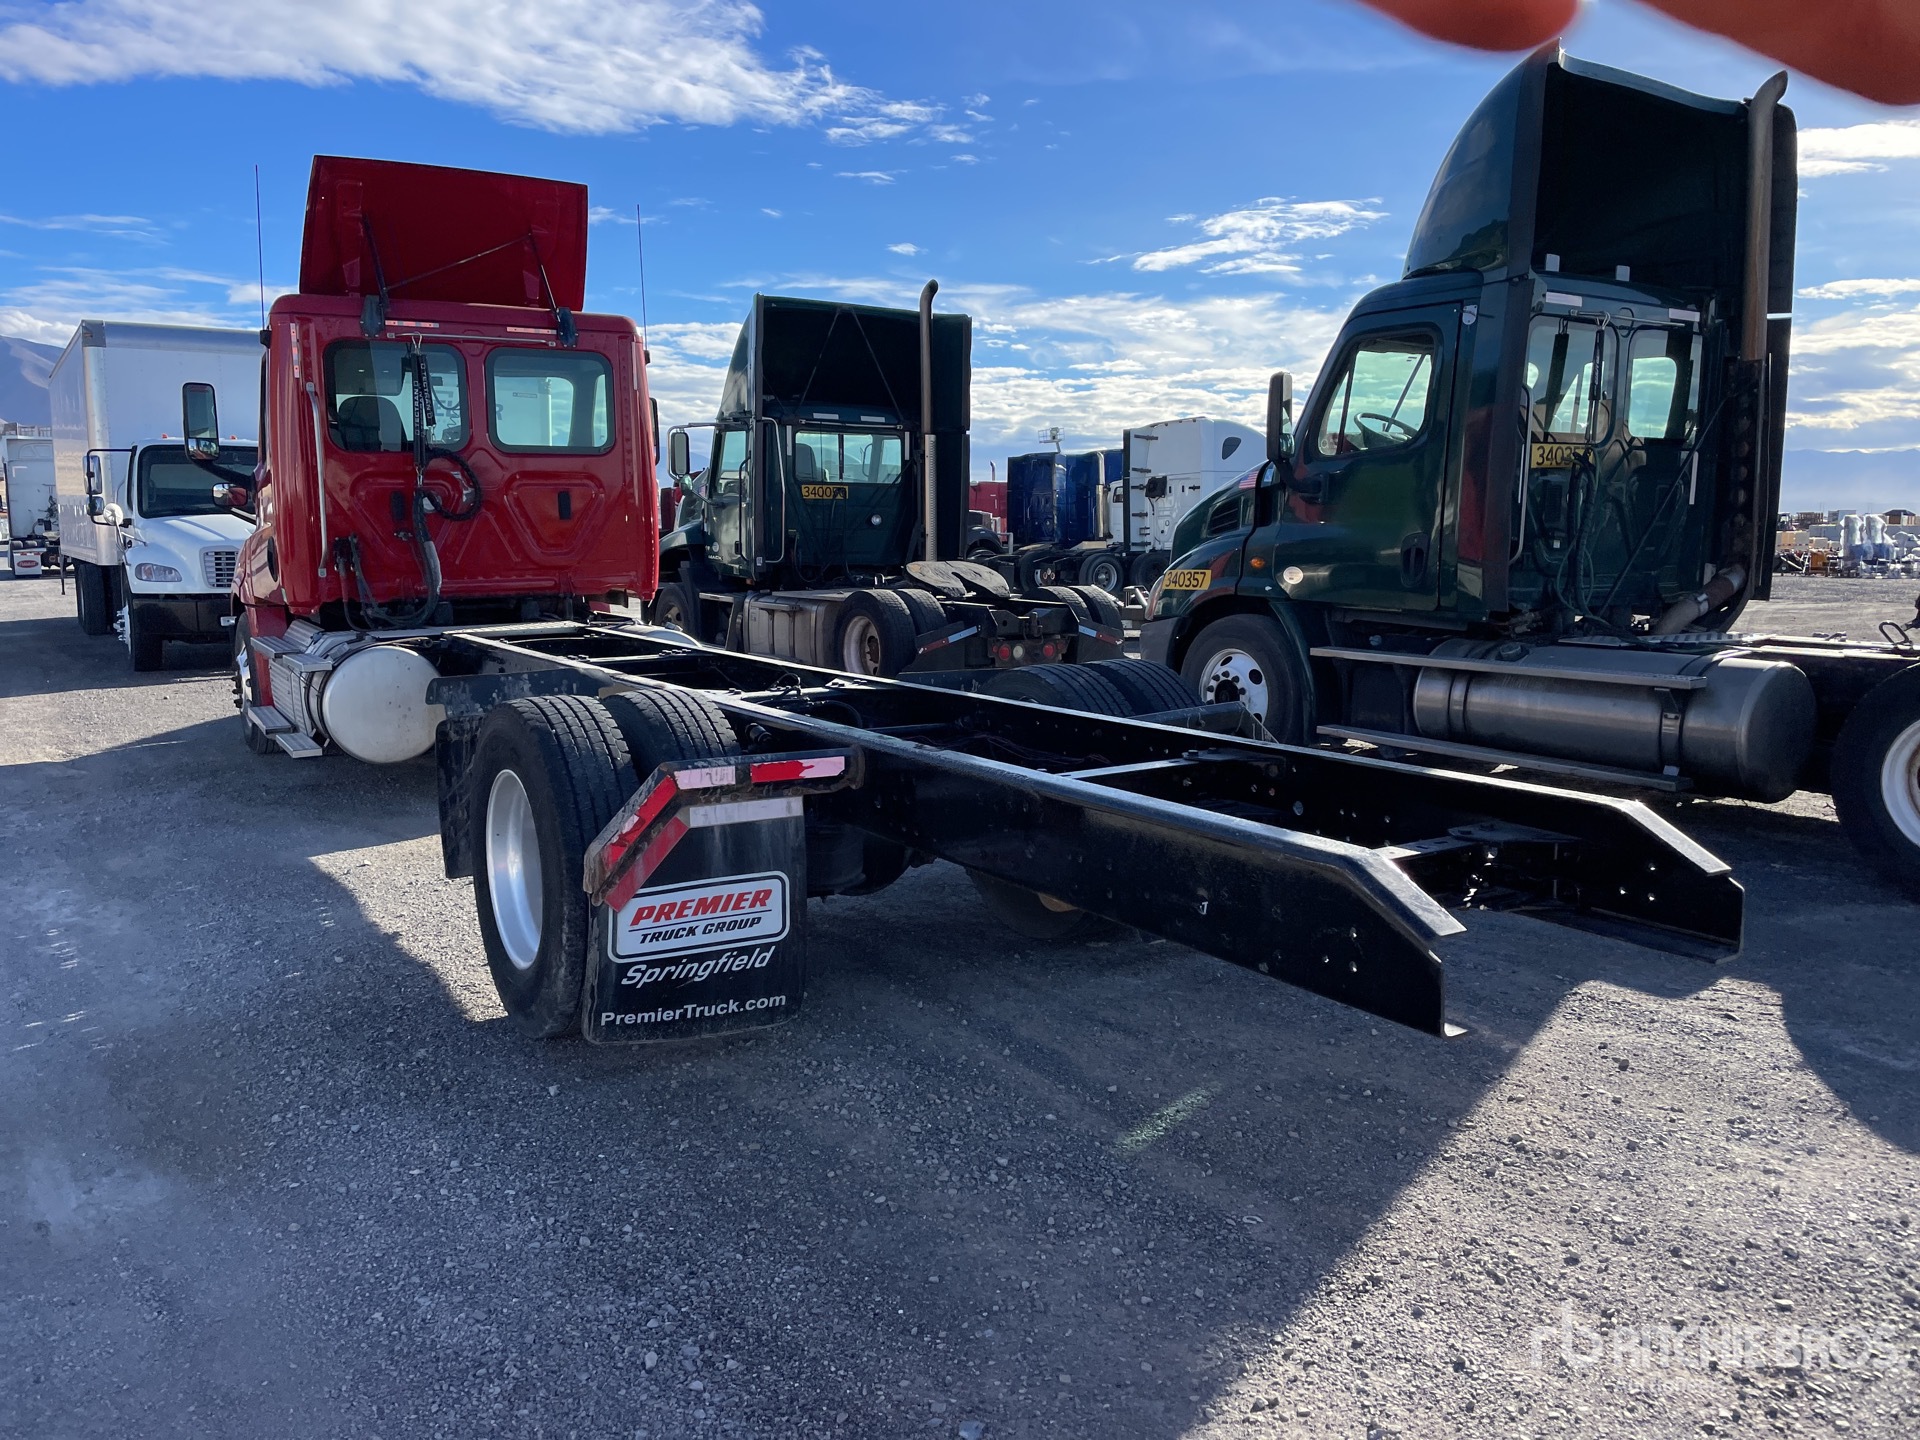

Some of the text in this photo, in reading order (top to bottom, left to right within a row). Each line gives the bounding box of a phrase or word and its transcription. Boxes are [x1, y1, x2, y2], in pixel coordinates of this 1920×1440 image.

[1165, 571, 1206, 588] 340357
[629, 888, 773, 926] PREMIER
[640, 917, 761, 944] TRUCK GROUP
[621, 946, 776, 988] Springfield
[601, 994, 786, 1025] PremierTruck.com
